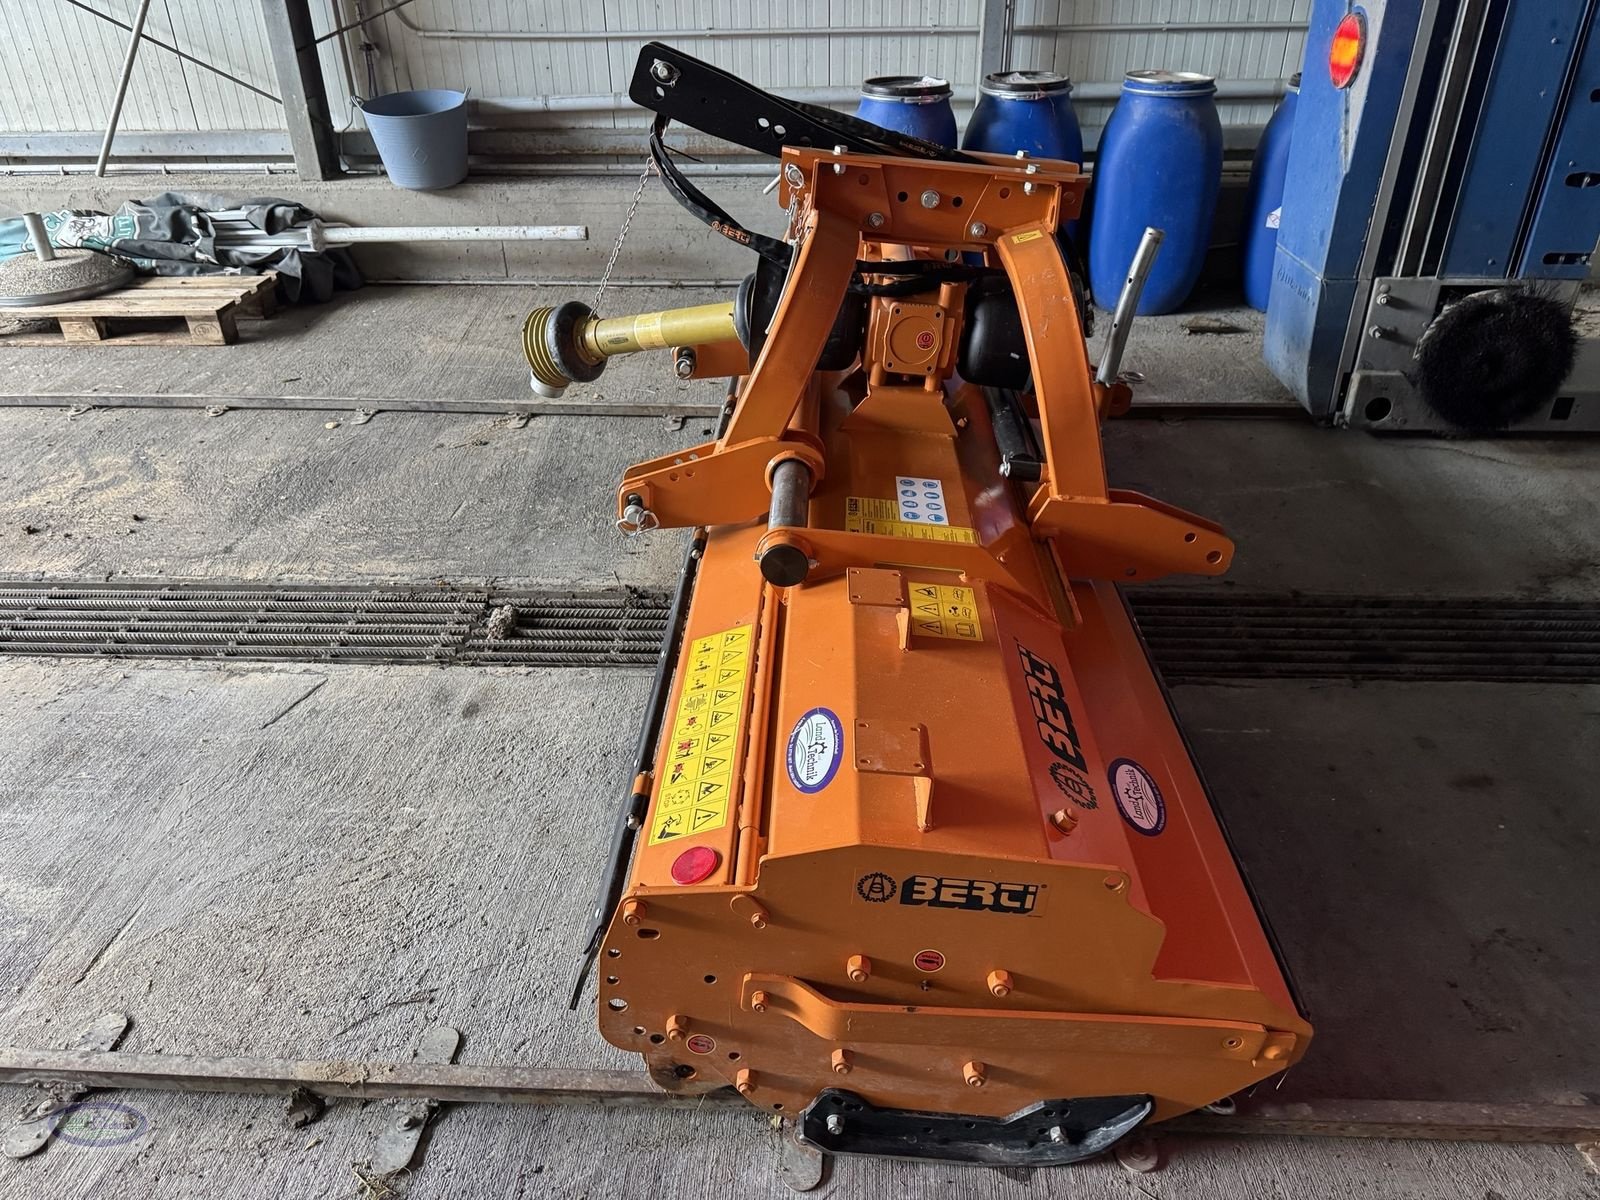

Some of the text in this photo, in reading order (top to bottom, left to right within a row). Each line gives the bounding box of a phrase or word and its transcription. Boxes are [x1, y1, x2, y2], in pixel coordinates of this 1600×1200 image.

[815, 722, 826, 741] Land
[806, 749, 818, 781] Technik
[1125, 768, 1144, 820] Land Technik
